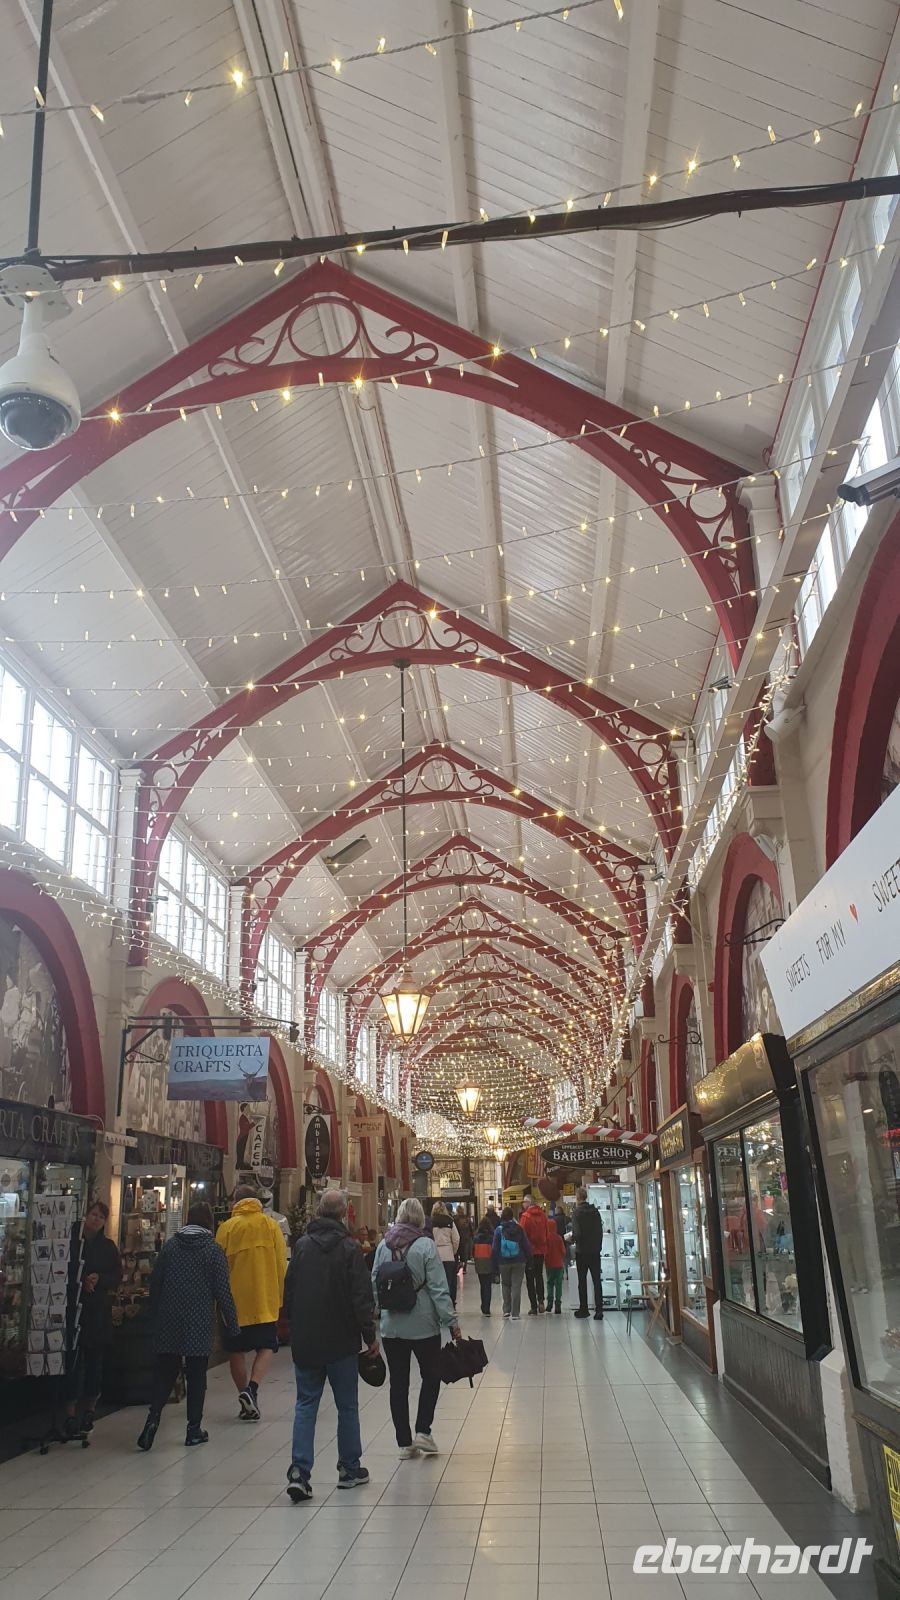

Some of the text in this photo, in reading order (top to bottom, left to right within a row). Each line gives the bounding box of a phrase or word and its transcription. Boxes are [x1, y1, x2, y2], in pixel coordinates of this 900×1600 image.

[786, 953, 811, 992] SWEETS
[816, 932, 834, 964] FOR
[831, 919, 847, 950] MY
[175, 1044, 263, 1060] TRIQUERTA
[173, 1060, 231, 1073] CRAFTS
[31, 1115, 81, 1152] CRAFTS
[252, 1125, 263, 1160] CAFE
[553, 1148, 600, 1162] BARBER
[602, 1147, 632, 1159] SHOP
